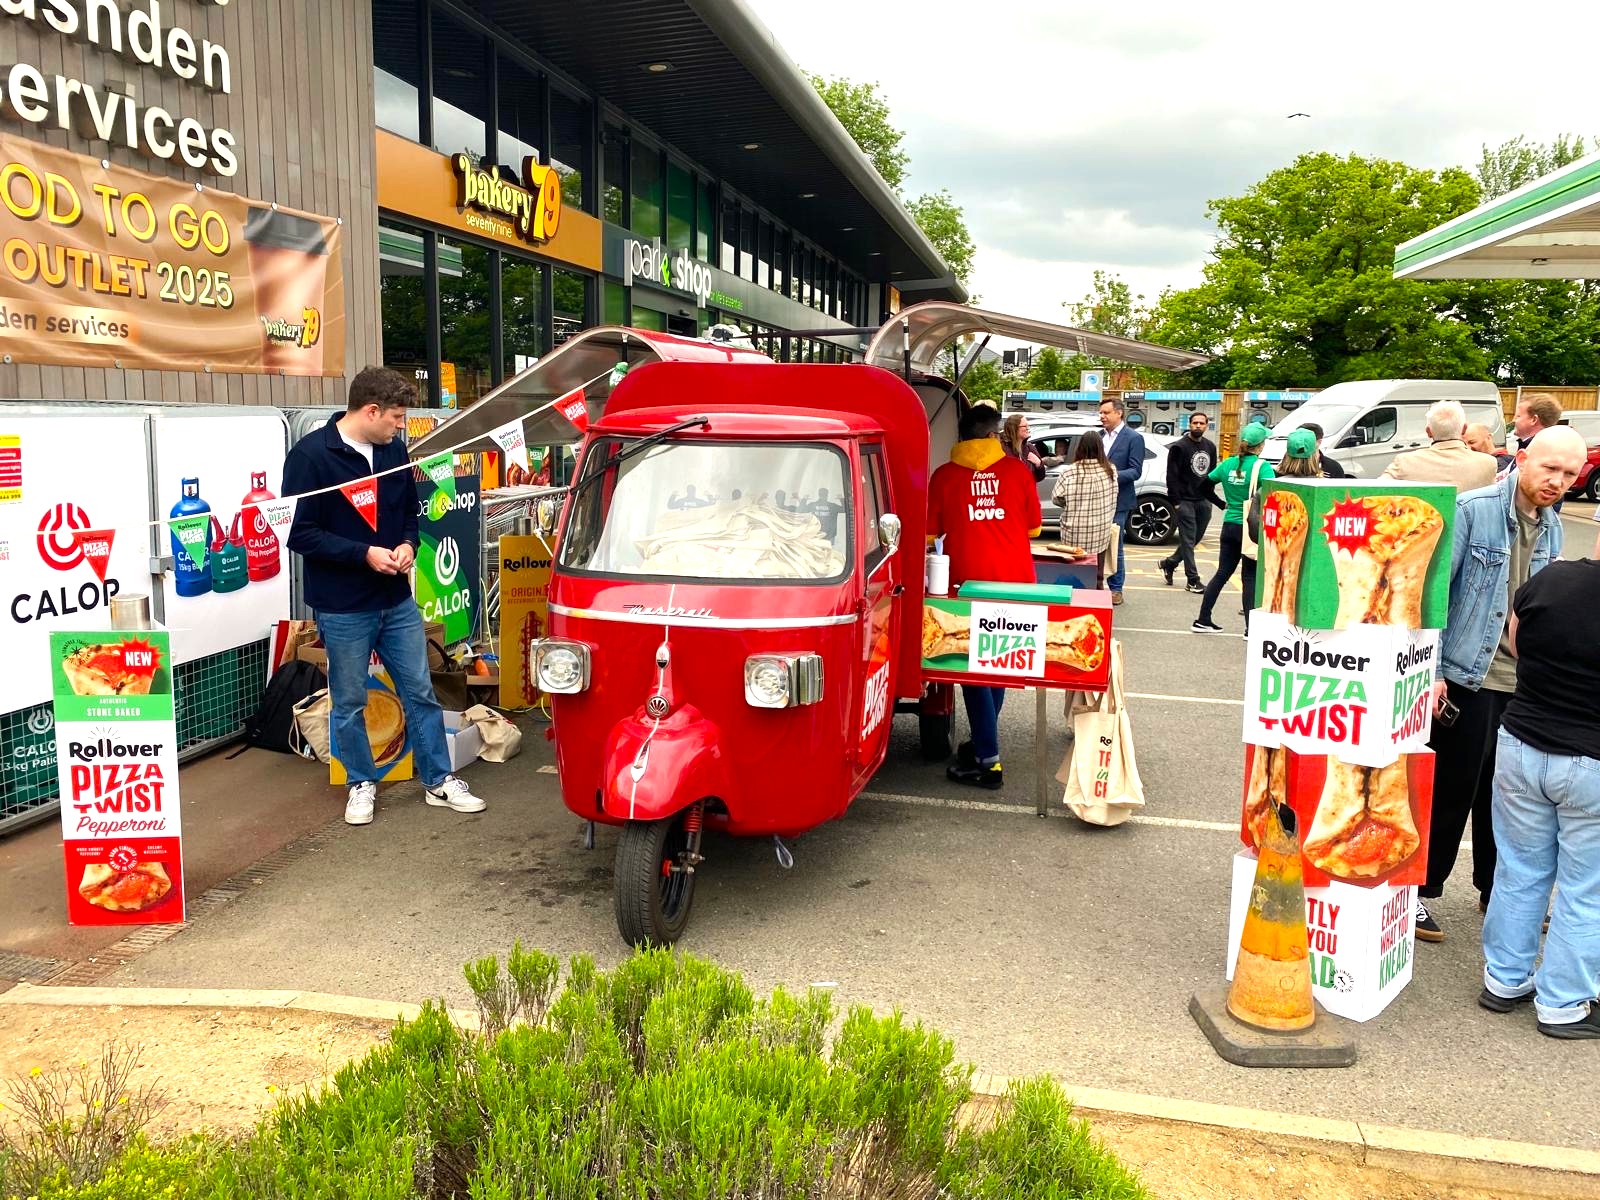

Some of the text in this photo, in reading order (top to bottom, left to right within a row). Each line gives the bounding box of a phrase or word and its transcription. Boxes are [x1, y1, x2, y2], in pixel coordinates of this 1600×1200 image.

[0, 63, 238, 177] ervices
[459, 155, 560, 240] bakery 79
[93, 183, 156, 241] TO
[168, 203, 230, 255] GO
[4, 238, 235, 309] OUTLET 2025
[676, 247, 711, 309] shop
[45, 315, 129, 339] services
[260, 315, 303, 346] bakery
[970, 480, 999, 496] ITALY
[973, 471, 996, 479] From
[968, 504, 1005, 521] love
[976, 497, 995, 507] With
[1265, 508, 1277, 527] NEW
[248, 535, 276, 548] CALOR
[1334, 517, 1367, 537] NEW
[423, 588, 471, 623] CALOR
[979, 617, 1038, 632] Rollover
[125, 651, 153, 667] NEW
[978, 633, 1036, 658] PIZZA
[978, 649, 1036, 671] TWIST
[1262, 640, 1370, 672] Rollover
[1396, 643, 1433, 676] Rollover
[863, 660, 889, 727] PIZZA
[1258, 667, 1368, 714] PIZZA
[1392, 668, 1430, 729] PIZZA
[1258, 703, 1368, 746] TWIST
[1391, 691, 1429, 744] TWIST
[69, 738, 163, 762] Rollover
[71, 764, 163, 801] PIZZA
[73, 782, 164, 814] TWIST
[76, 815, 166, 837] Pepperoni
[1307, 897, 1340, 930] TLY
[1382, 885, 1411, 932] EXACTLY
[1307, 927, 1337, 955] YOU
[1381, 922, 1397, 956] WHAT
[1398, 912, 1409, 940] YOU
